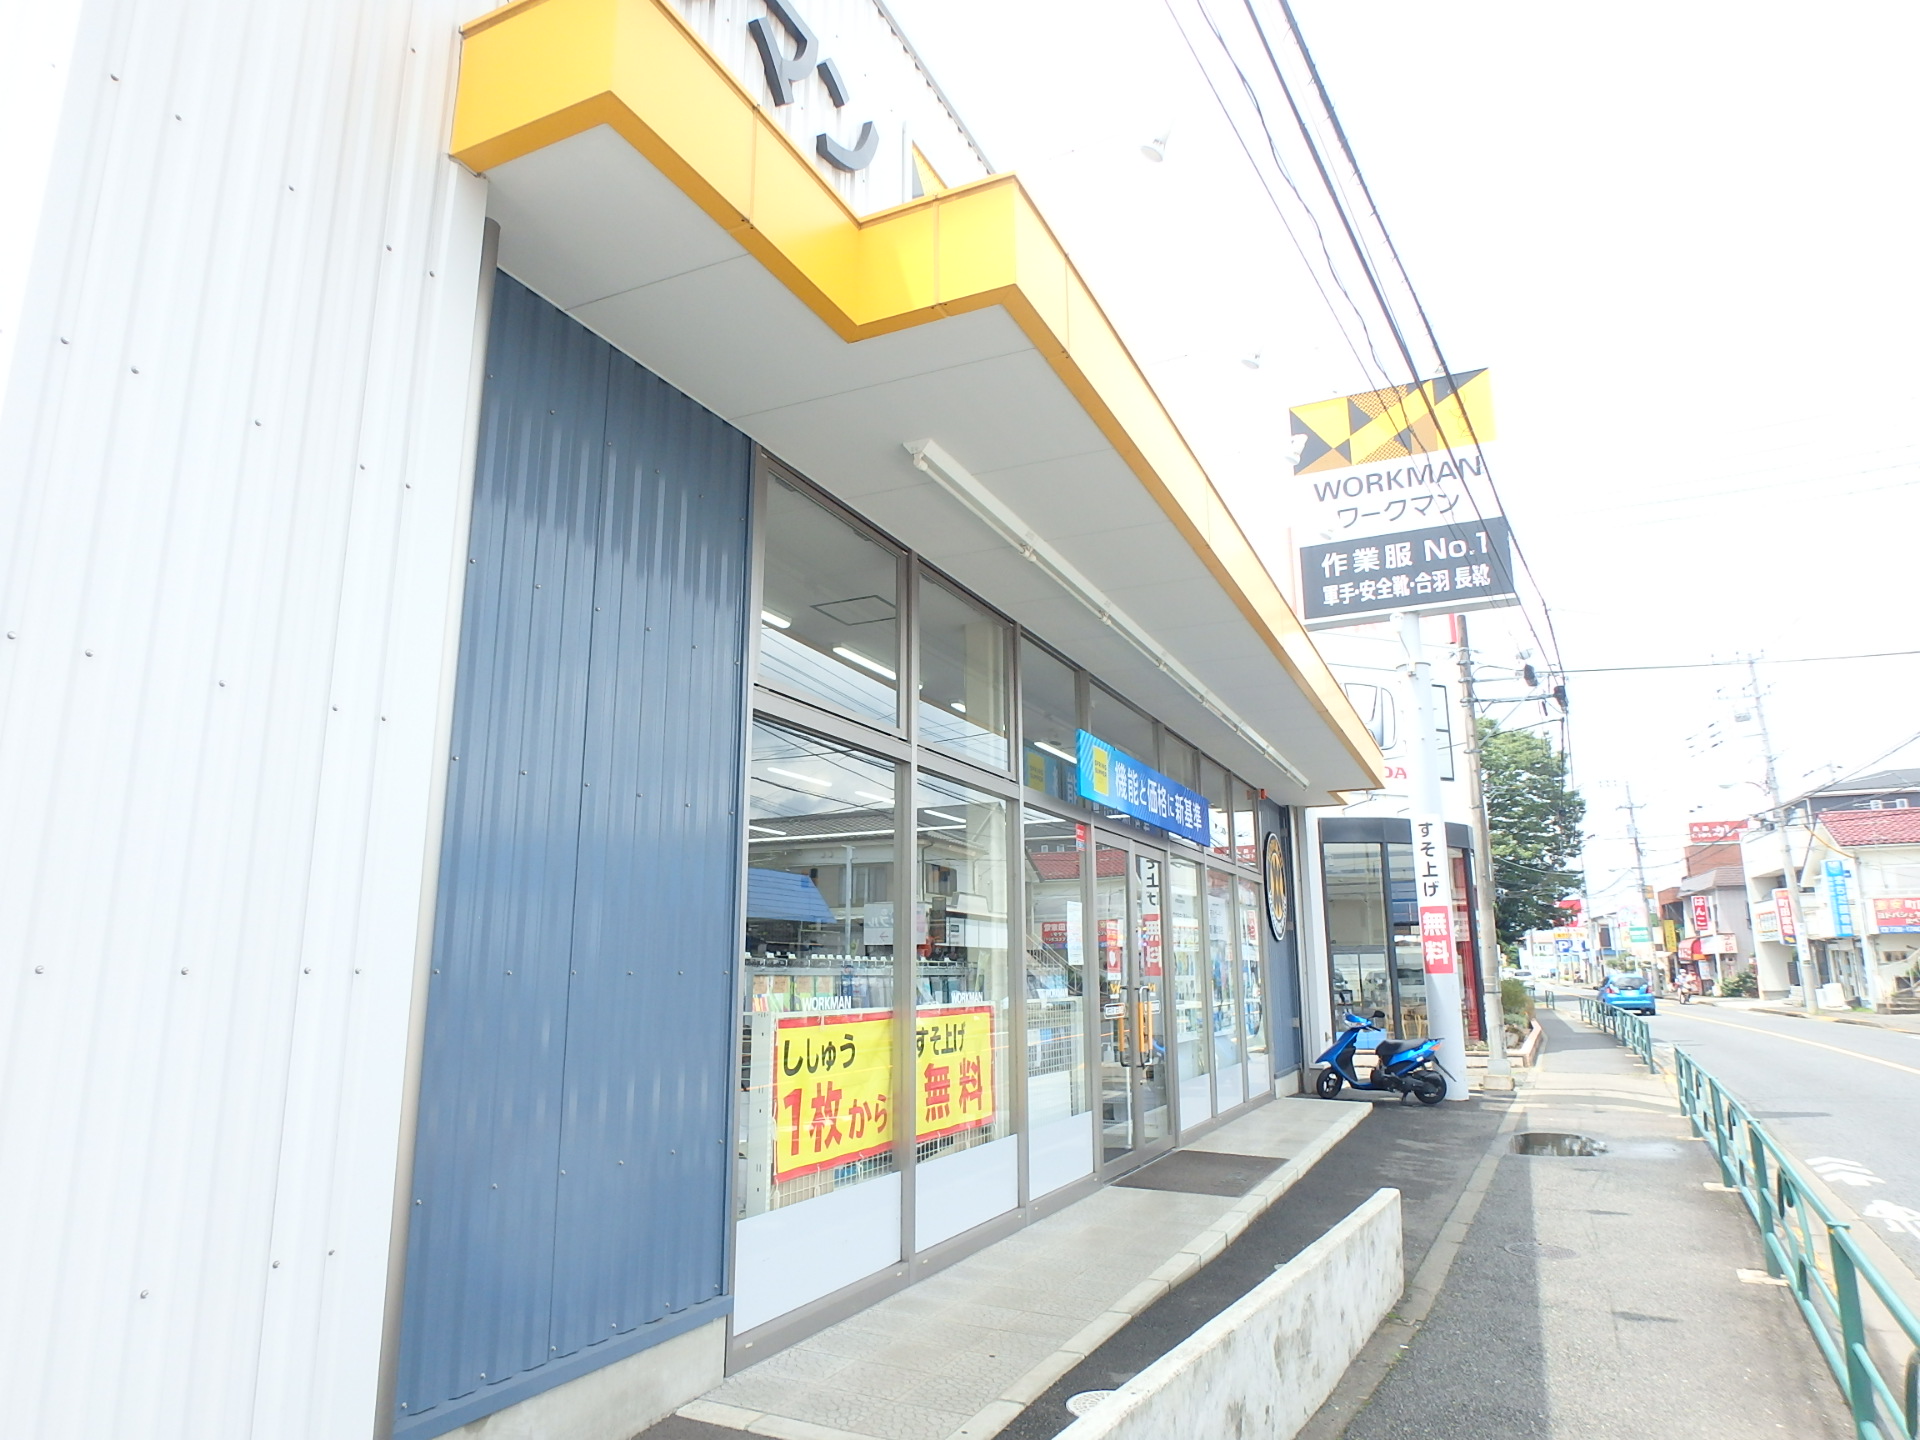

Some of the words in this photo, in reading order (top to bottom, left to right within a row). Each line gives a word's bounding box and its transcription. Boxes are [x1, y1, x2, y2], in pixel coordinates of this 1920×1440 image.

[1313, 456, 1482, 502] WORKMAN
[1337, 494, 1460, 528] ワークマン
[1321, 541, 1413, 578] 作業服
[1424, 531, 1488, 562] No.1
[1115, 760, 1203, 832] 機能と価格に新基準
[1418, 821, 1439, 898] すそ上げ
[1423, 911, 1450, 966] 無料
[801, 995, 852, 1011] WORKMAN
[951, 991, 984, 1004] WORKMAN
[783, 1033, 856, 1077] ししゅう
[916, 1022, 966, 1058] すそ上げ
[923, 1055, 983, 1122] 無料
[783, 1080, 888, 1156] 1枚から
